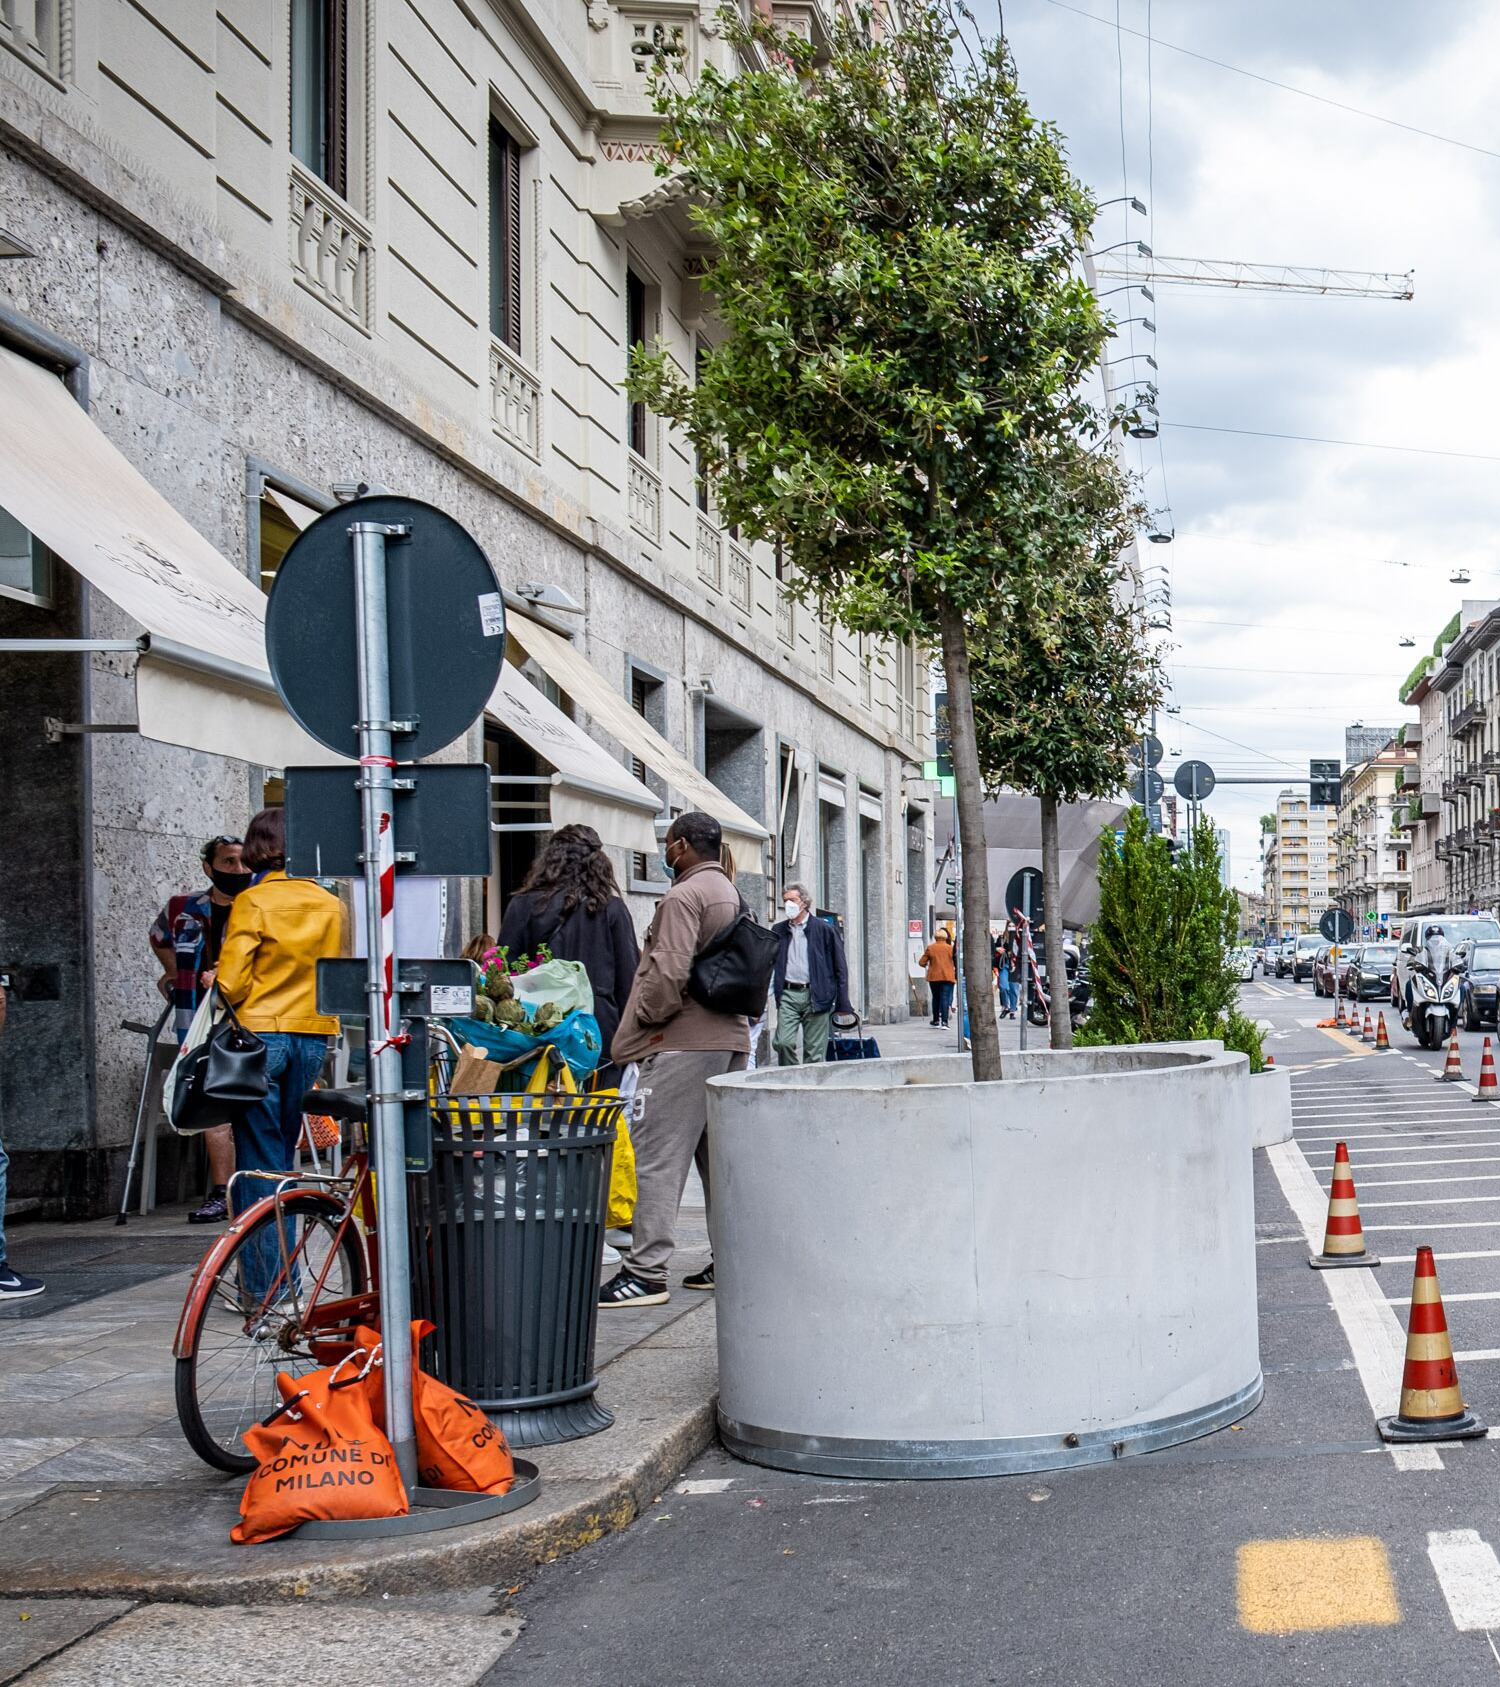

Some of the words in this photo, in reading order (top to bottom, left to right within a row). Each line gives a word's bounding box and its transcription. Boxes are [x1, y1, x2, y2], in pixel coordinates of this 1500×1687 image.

[259, 1448, 363, 1479] COMUNE
[370, 1451, 391, 1468] DI
[275, 1470, 375, 1493] MILANO
